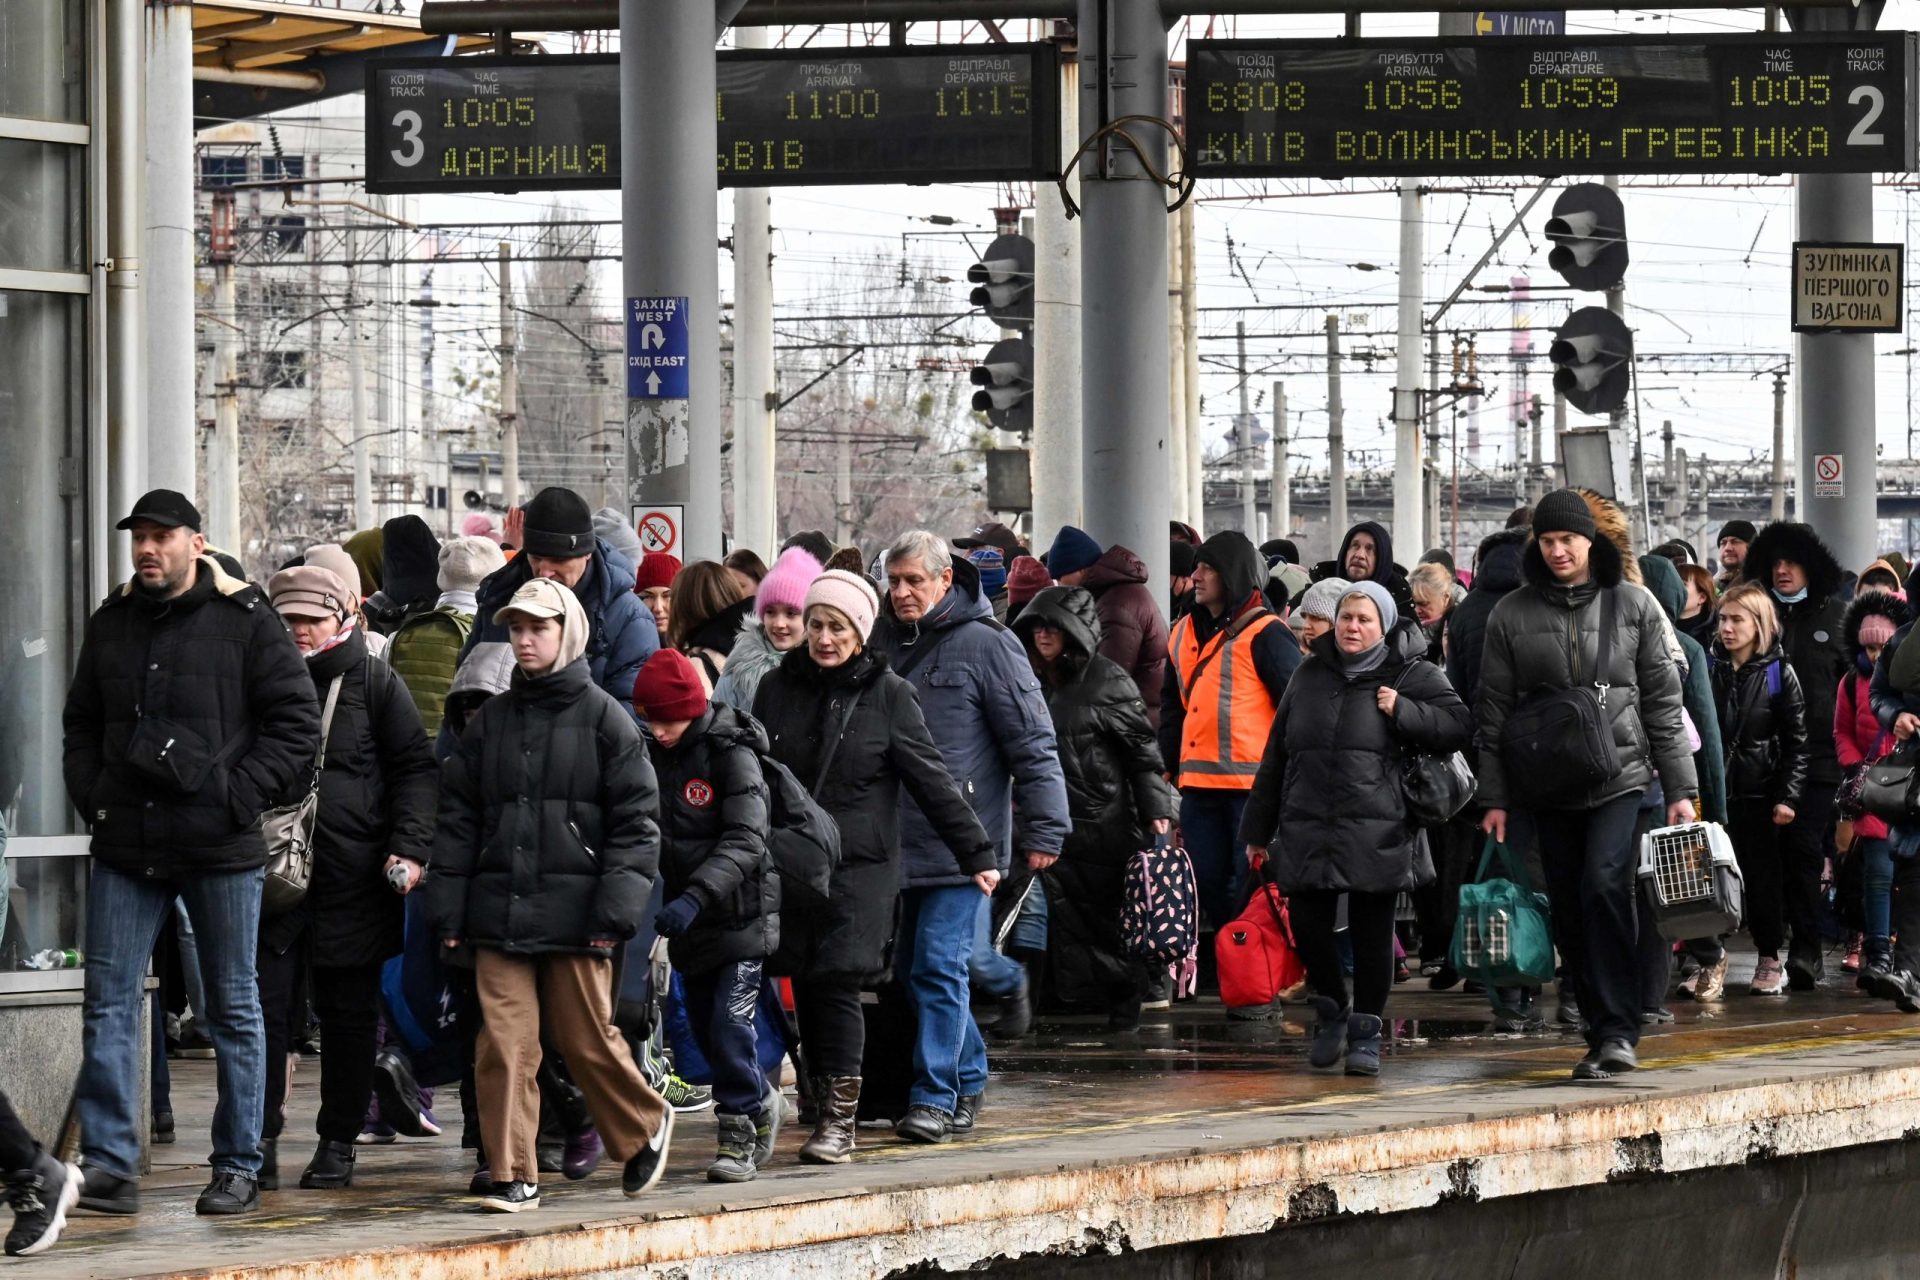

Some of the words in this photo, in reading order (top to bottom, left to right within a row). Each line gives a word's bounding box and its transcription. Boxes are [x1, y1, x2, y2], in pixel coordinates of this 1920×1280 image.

[1513, 15, 1555, 35] МІСТО
[1237, 54, 1275, 67] ПОЇЗД
[1378, 53, 1444, 65] ПРИБУТТЯ
[1533, 51, 1600, 63] ВІДПРАВЛ.
[1766, 49, 1791, 60] ЧАС
[1847, 48, 1884, 60] КОЛІЯ
[800, 63, 862, 76] ПРИБУТТЯ
[949, 59, 1012, 73] ВІДПРАВЛ.
[1385, 65, 1437, 77] ARRIVAL
[1529, 62, 1604, 75] DEPARTURE
[1764, 61, 1794, 72] TIME
[1847, 60, 1885, 71] TRACK
[475, 72, 498, 83] ЧАС
[945, 72, 1017, 84] DEPARTURE
[1238, 68, 1275, 78] TRAIN
[390, 74, 424, 86] КОЛІЯ
[806, 75, 856, 87] ARRIVAL
[390, 86, 425, 97] TRACK
[473, 83, 500, 95] TIME
[1364, 79, 1462, 110] 10:56
[1520, 77, 1618, 109] 10:59
[1731, 75, 1830, 106] 10:05
[936, 85, 1030, 117] 11:15
[1208, 81, 1305, 112] 6808
[785, 88, 879, 119] 11:00
[441, 97, 535, 127] 10:05
[1846, 85, 1885, 146] 2
[390, 110, 425, 168] 3
[1207, 131, 1305, 162] КИЇВ
[441, 144, 606, 176] ДАРНИЦЯ
[1804, 253, 1891, 272] ЗУПИНКА
[1804, 278, 1890, 297] ПЕРШОГО
[634, 299, 676, 311] ЗАХІД
[1811, 302, 1882, 321] ВАГОНА
[635, 312, 674, 322] WEST
[629, 356, 651, 368] СХІД
[654, 356, 685, 366] EAST
